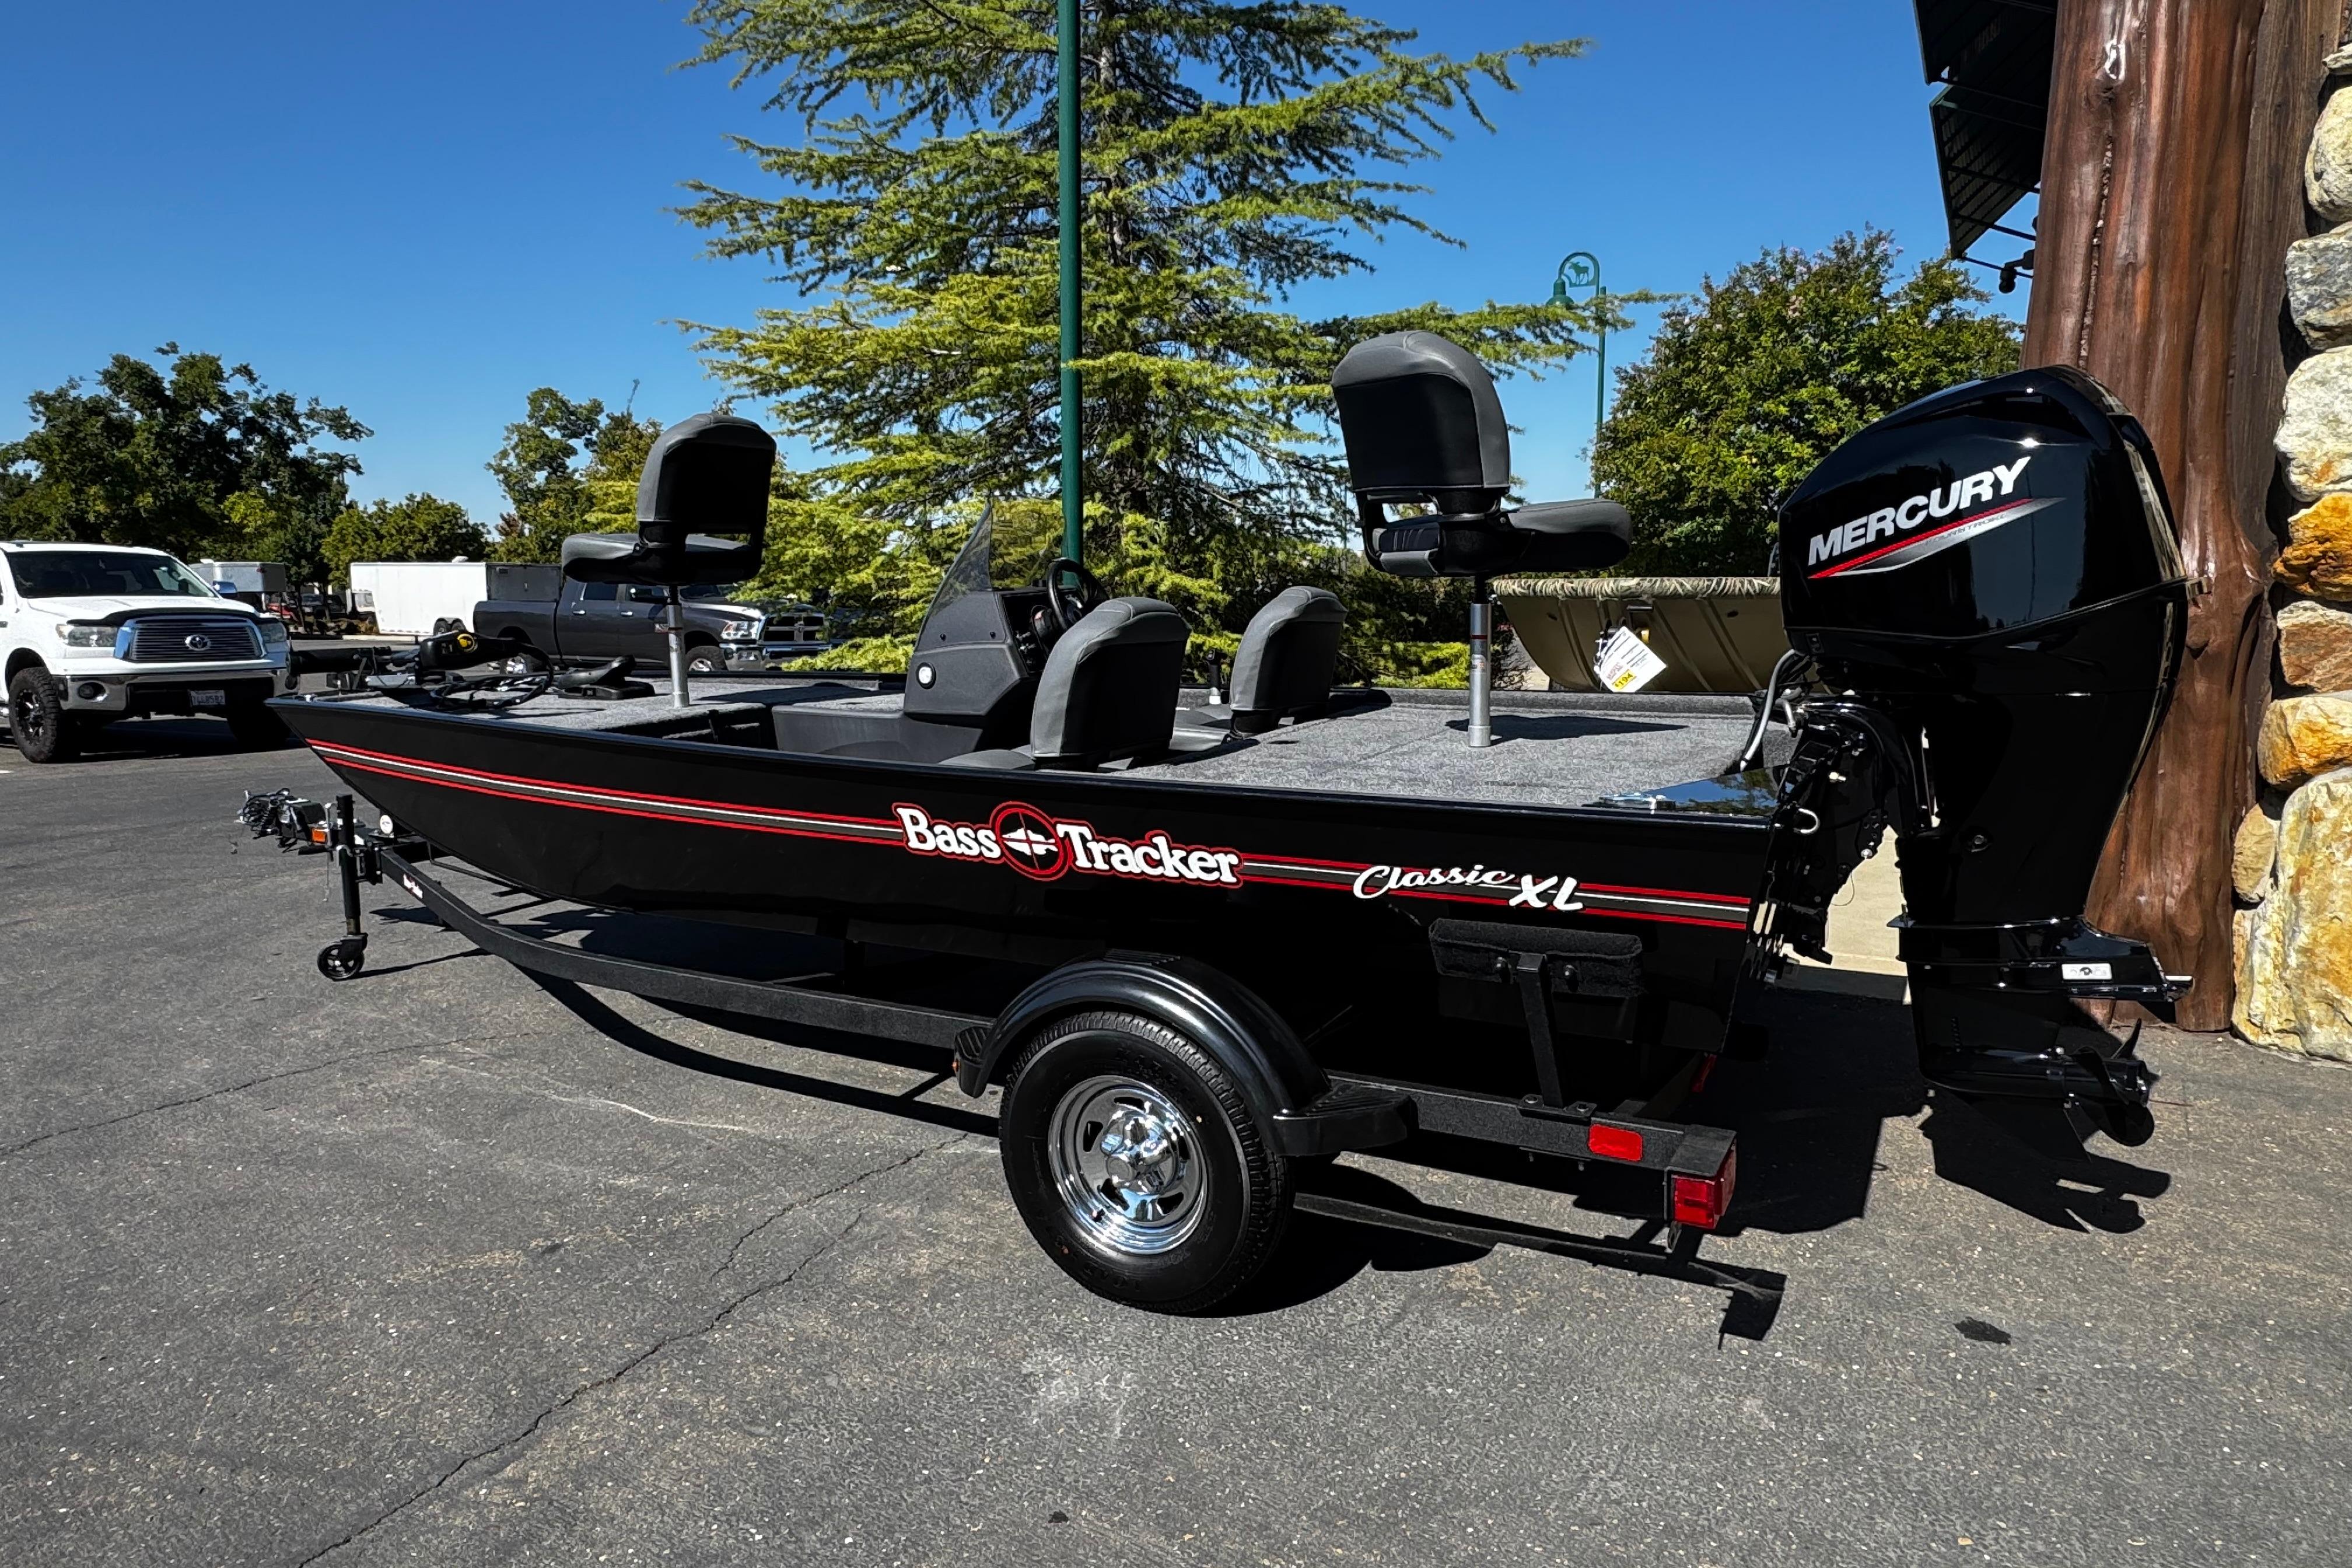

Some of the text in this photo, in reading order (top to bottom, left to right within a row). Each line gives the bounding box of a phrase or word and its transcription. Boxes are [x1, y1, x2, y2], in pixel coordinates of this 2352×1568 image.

[1808, 456, 2031, 566] MERCURY
[896, 807, 1239, 883] Bass Tracker
[1352, 864, 1583, 911] Classic XL
